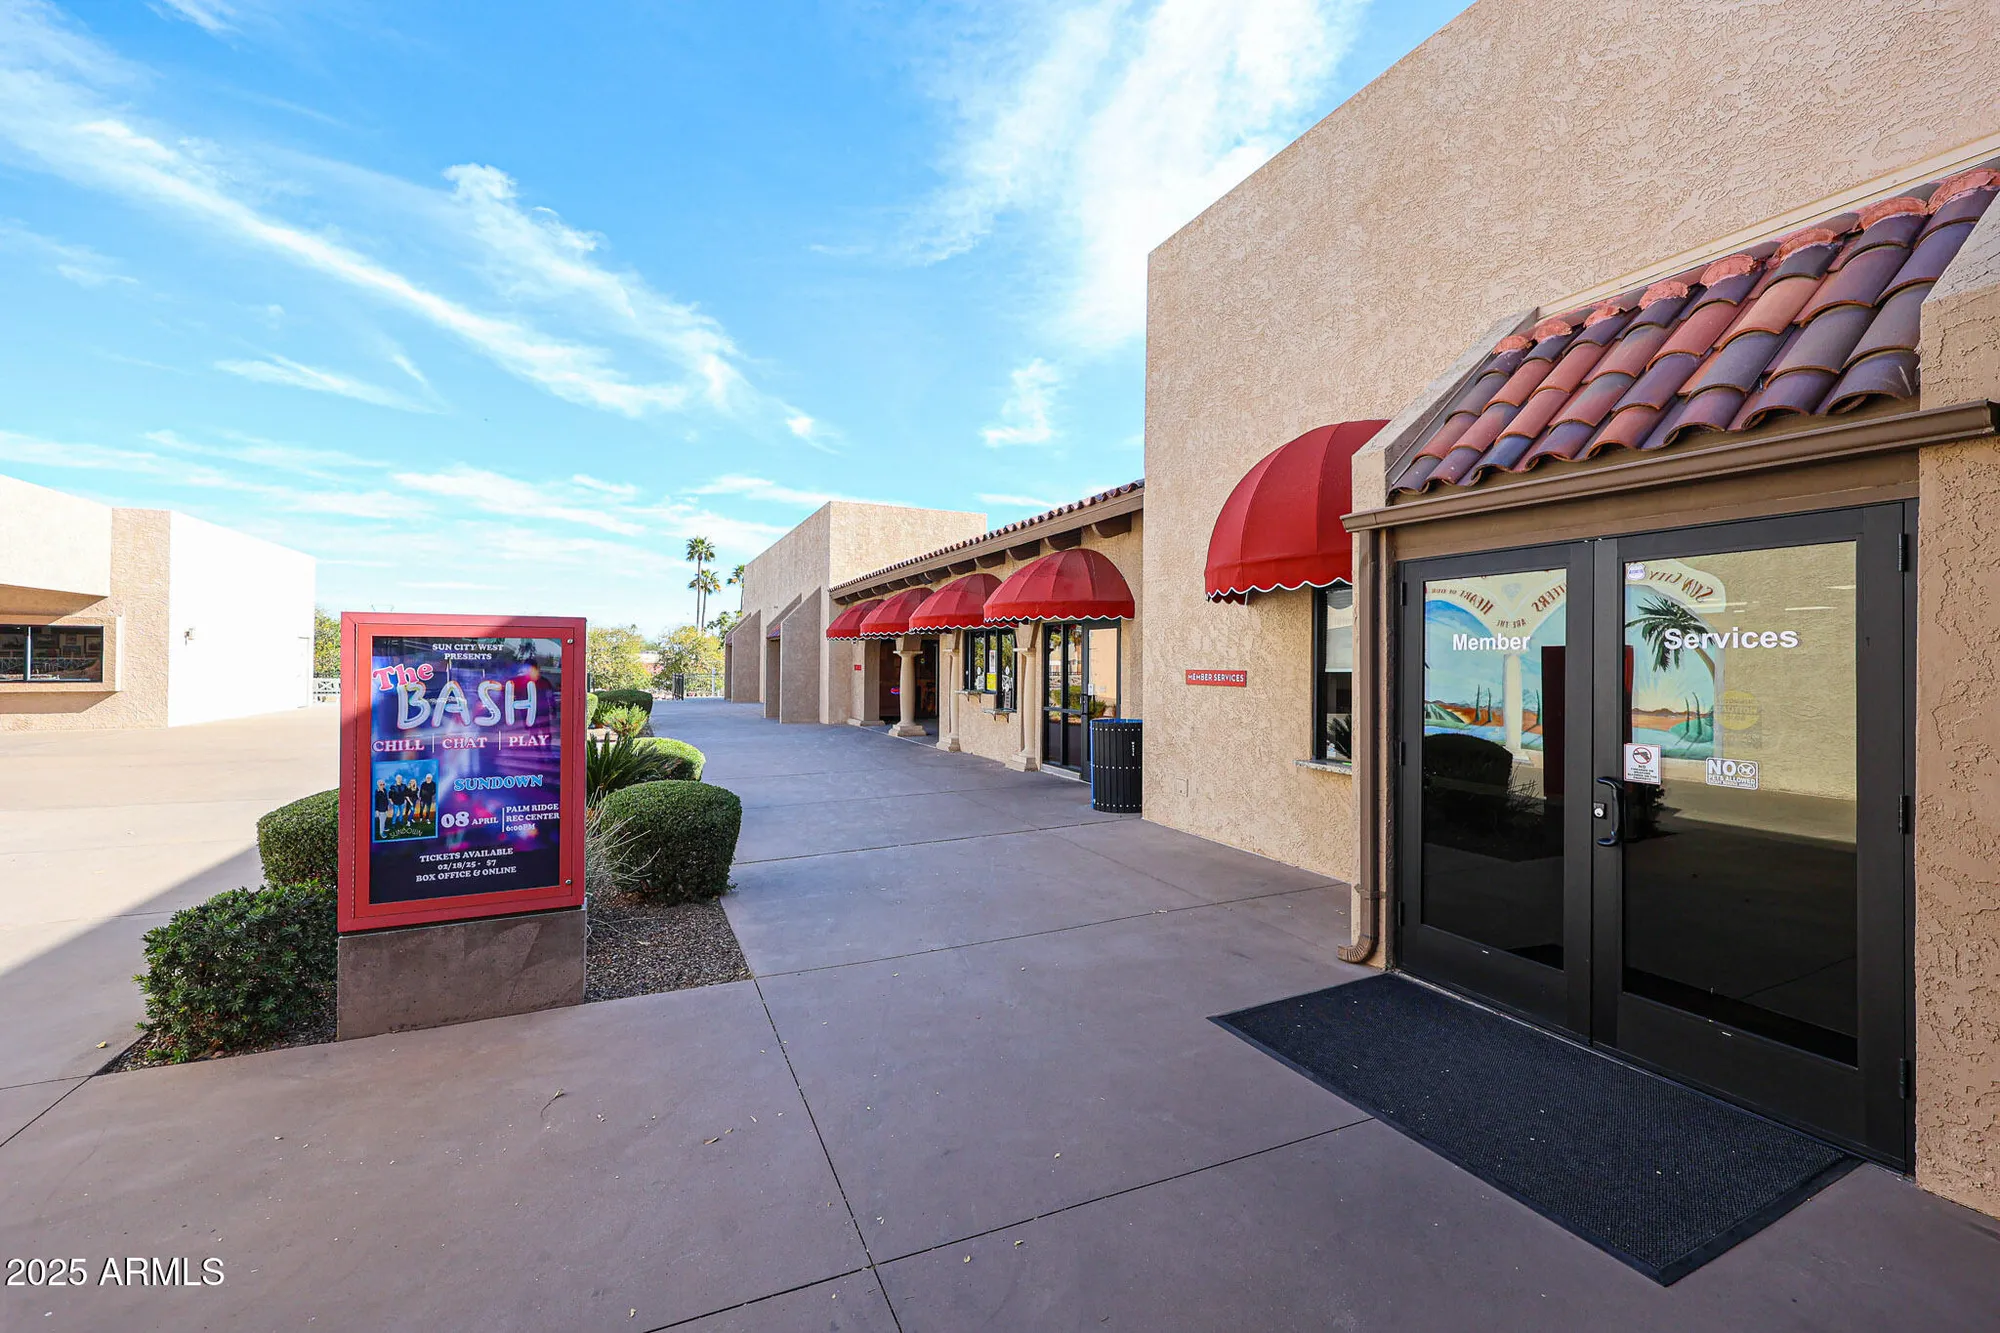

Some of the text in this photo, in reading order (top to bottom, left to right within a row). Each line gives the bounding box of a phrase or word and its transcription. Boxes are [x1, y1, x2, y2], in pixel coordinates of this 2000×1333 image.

[1452, 626, 1799, 651] Member Services
[432, 643, 452, 651] SUN
[453, 643, 475, 651] CITY
[372, 663, 434, 691] The
[1187, 673, 1244, 682] MEMBER SERVICES
[397, 680, 537, 730] BASH
[372, 734, 550, 752] CHILL CHAT PLAY
[1708, 760, 1737, 776] NO
[453, 775, 543, 791] SUNDOWN
[1708, 774, 1724, 782] PETS
[1726, 776, 1756, 785] ALLOWED
[506, 803, 559, 813] PALM RIDGE
[440, 811, 499, 828] 08 APRIL
[506, 812, 560, 822] REC CENTER
[419, 848, 514, 863] TICKETS AVAILABLE
[415, 866, 517, 882] BOX OFFICE & ONLINE
